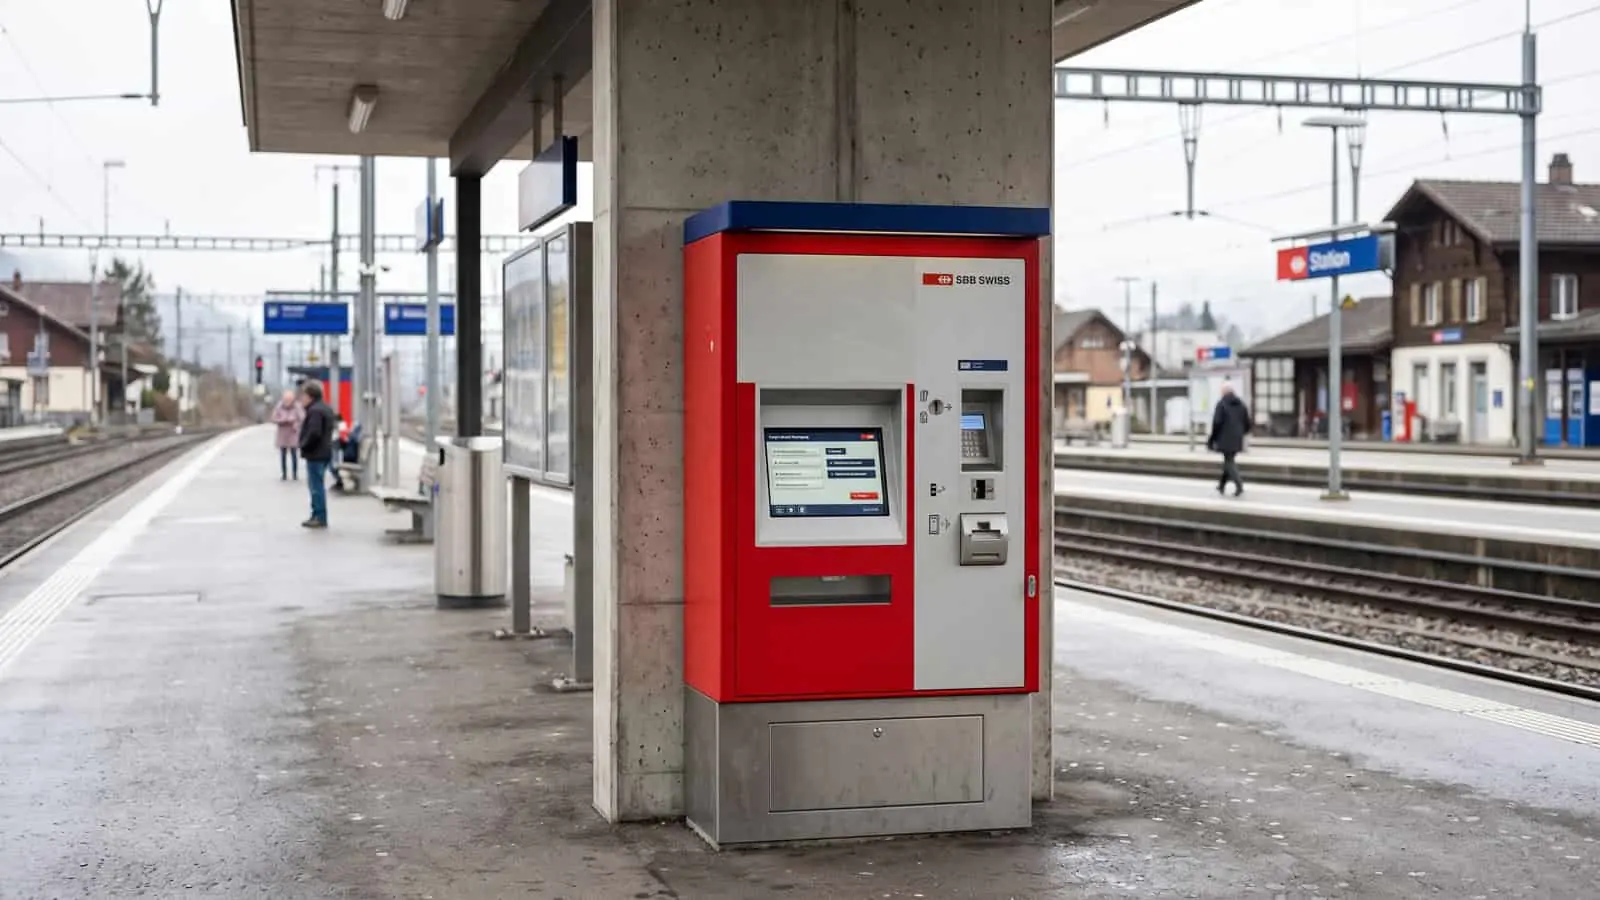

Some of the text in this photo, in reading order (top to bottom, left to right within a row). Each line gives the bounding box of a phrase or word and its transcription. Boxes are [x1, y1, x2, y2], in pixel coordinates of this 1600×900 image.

[1309, 248, 1351, 272] Station
[956, 275, 1011, 286] SBB SWISS
